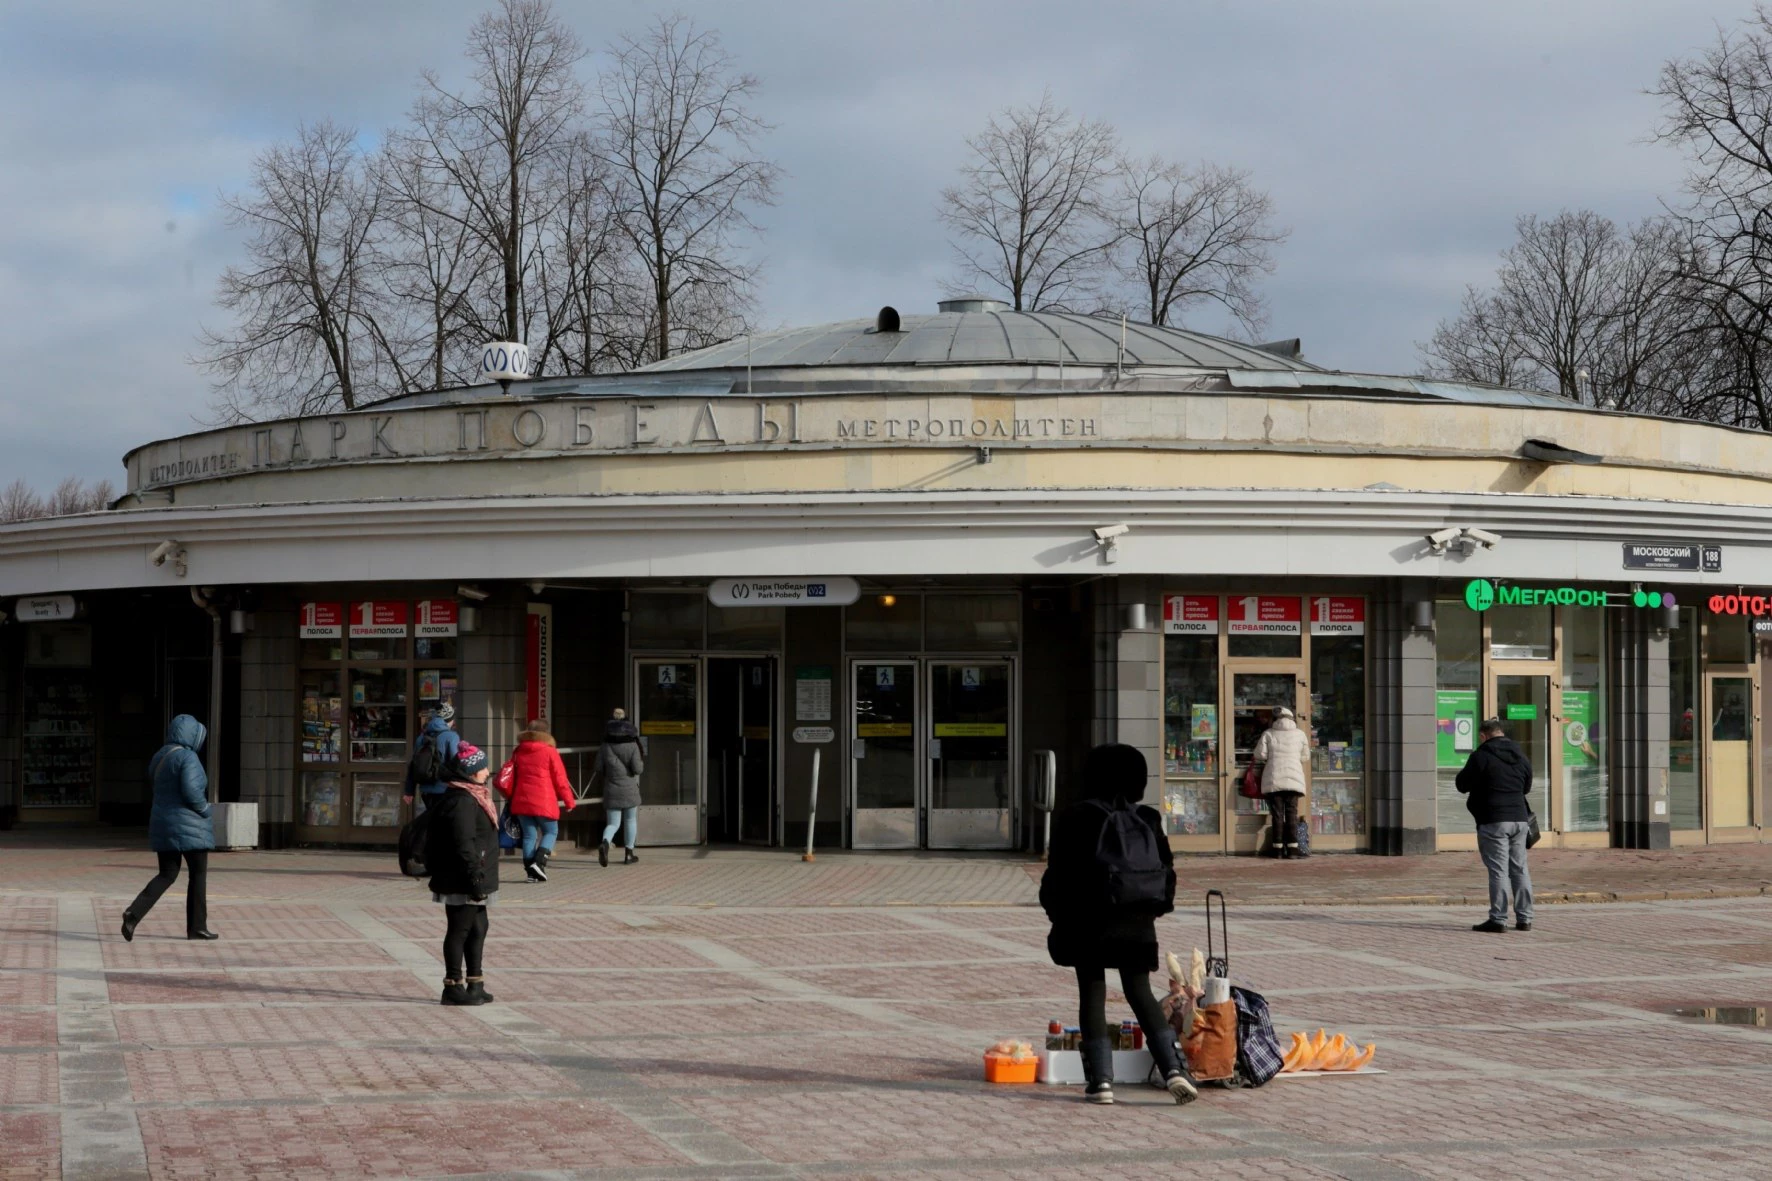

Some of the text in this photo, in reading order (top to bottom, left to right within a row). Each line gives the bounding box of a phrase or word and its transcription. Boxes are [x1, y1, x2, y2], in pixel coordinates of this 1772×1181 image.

[149, 402, 1099, 484] МЕТРОПОЛИТЕН ПАРК ПОБЕДЫ МЕТРОПОЛИТЕН
[1632, 546, 1691, 558] МОСКОВСКИЙ
[1705, 551, 1719, 562] 188
[752, 583, 772, 592] Парк
[774, 582, 806, 591] Победы
[775, 592, 801, 600] Pobedy
[1708, 594, 1772, 616] ФОТО-
[306, 627, 333, 635] ПОЛОСА
[351, 627, 404, 635] ПЕРВАЯПОЛОСА
[1173, 623, 1207, 631] ПОЛОСА
[1231, 624, 1297, 632] ПЕРВАЯПОЛОСА
[1319, 624, 1353, 632] ПОЛОСА
